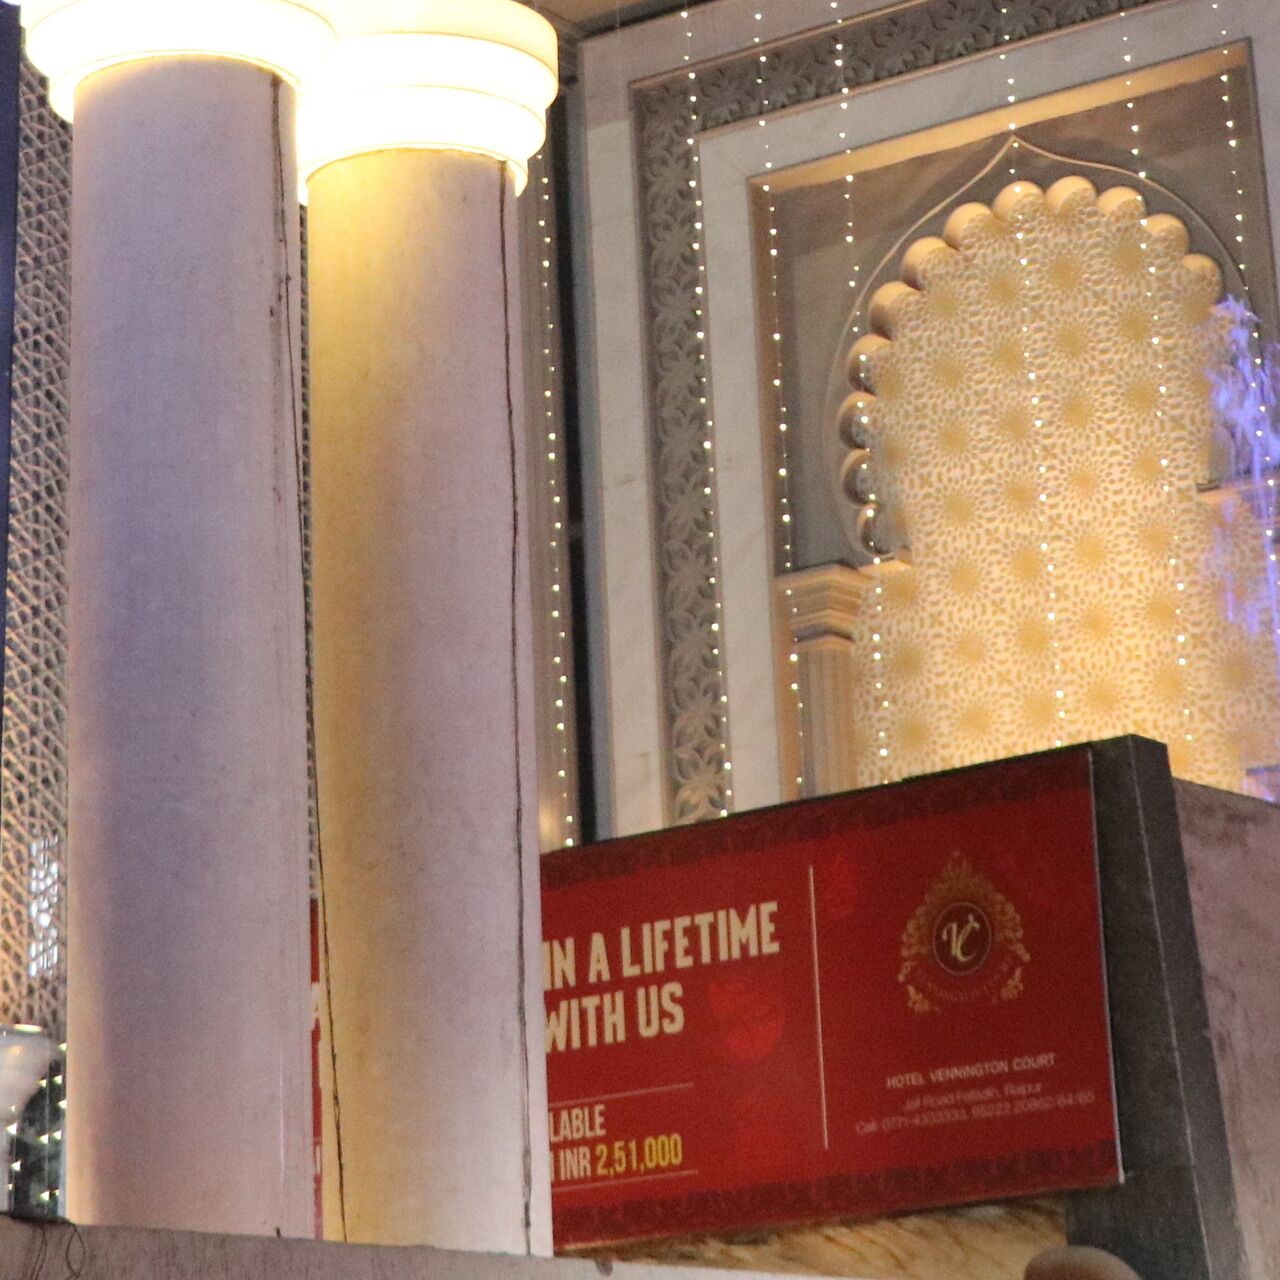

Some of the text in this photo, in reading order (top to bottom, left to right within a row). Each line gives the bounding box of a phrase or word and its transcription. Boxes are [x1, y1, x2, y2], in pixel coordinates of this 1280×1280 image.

[588, 933, 611, 983] A
[621, 901, 780, 978] LIFETIME
[544, 981, 686, 1054] WITH US
[885, 1051, 1058, 1090] HOTEL VENNINGTON COURT
[560, 1145, 591, 1180] INR
[595, 1132, 683, 1178] 2,51,000
